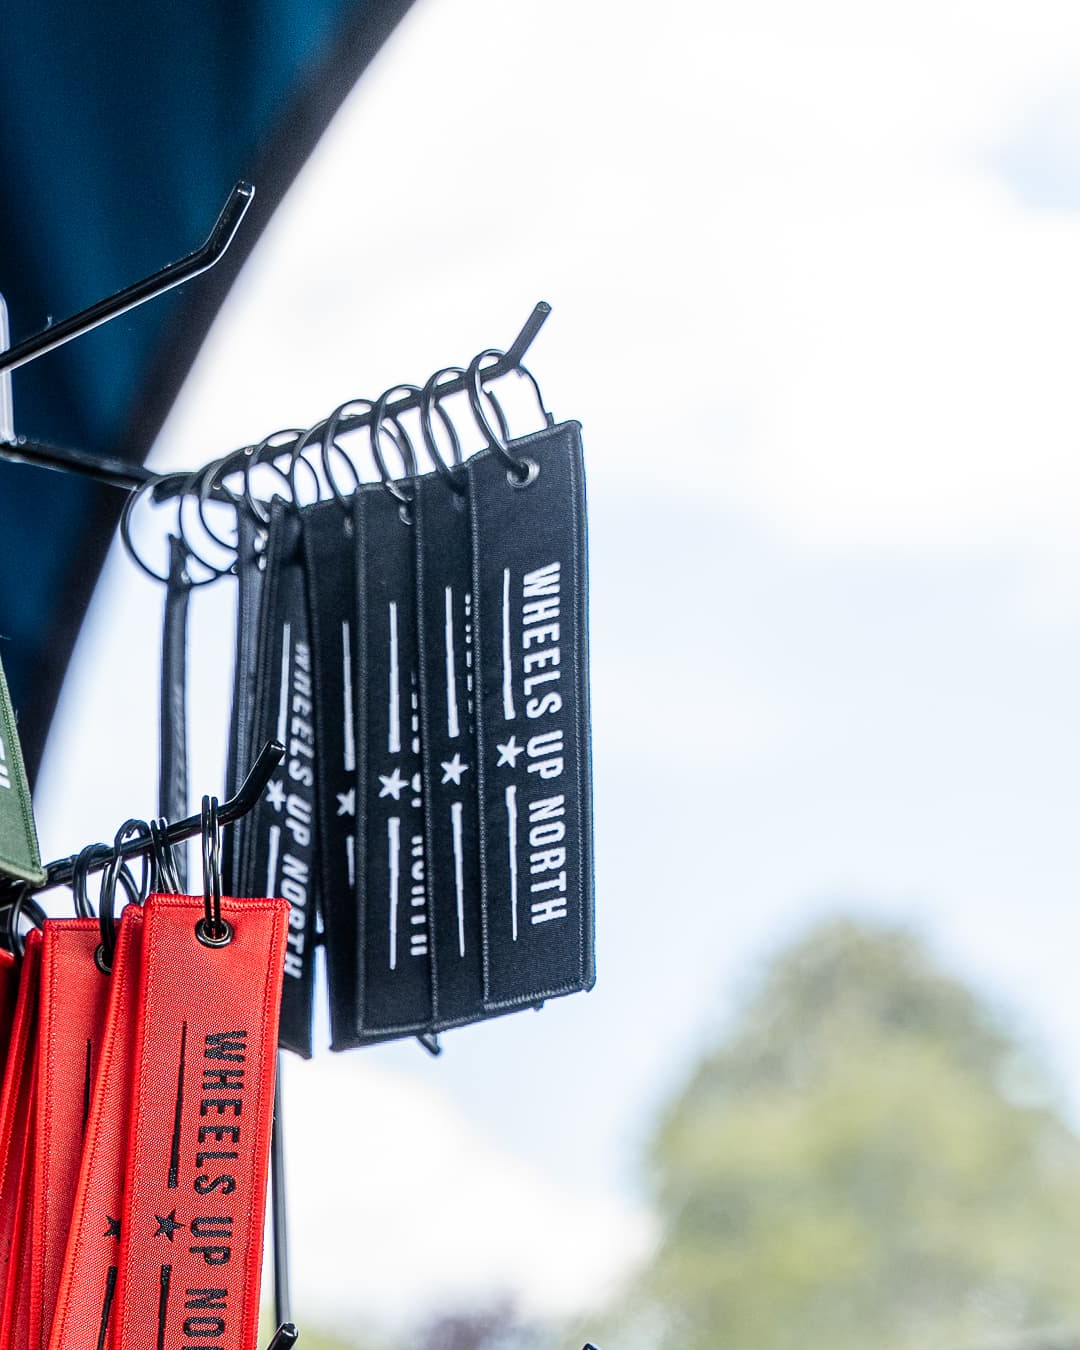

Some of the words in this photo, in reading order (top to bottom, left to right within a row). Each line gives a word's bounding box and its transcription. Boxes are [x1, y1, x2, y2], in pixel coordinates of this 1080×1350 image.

[523, 562, 562, 718] WHEELS
[289, 642, 313, 786] WHEELS
[527, 730, 563, 779] UP
[286, 794, 311, 846] UP
[529, 795, 567, 924] NORTH
[194, 1030, 247, 1196] WHEELS
[189, 1215, 233, 1267] UP
